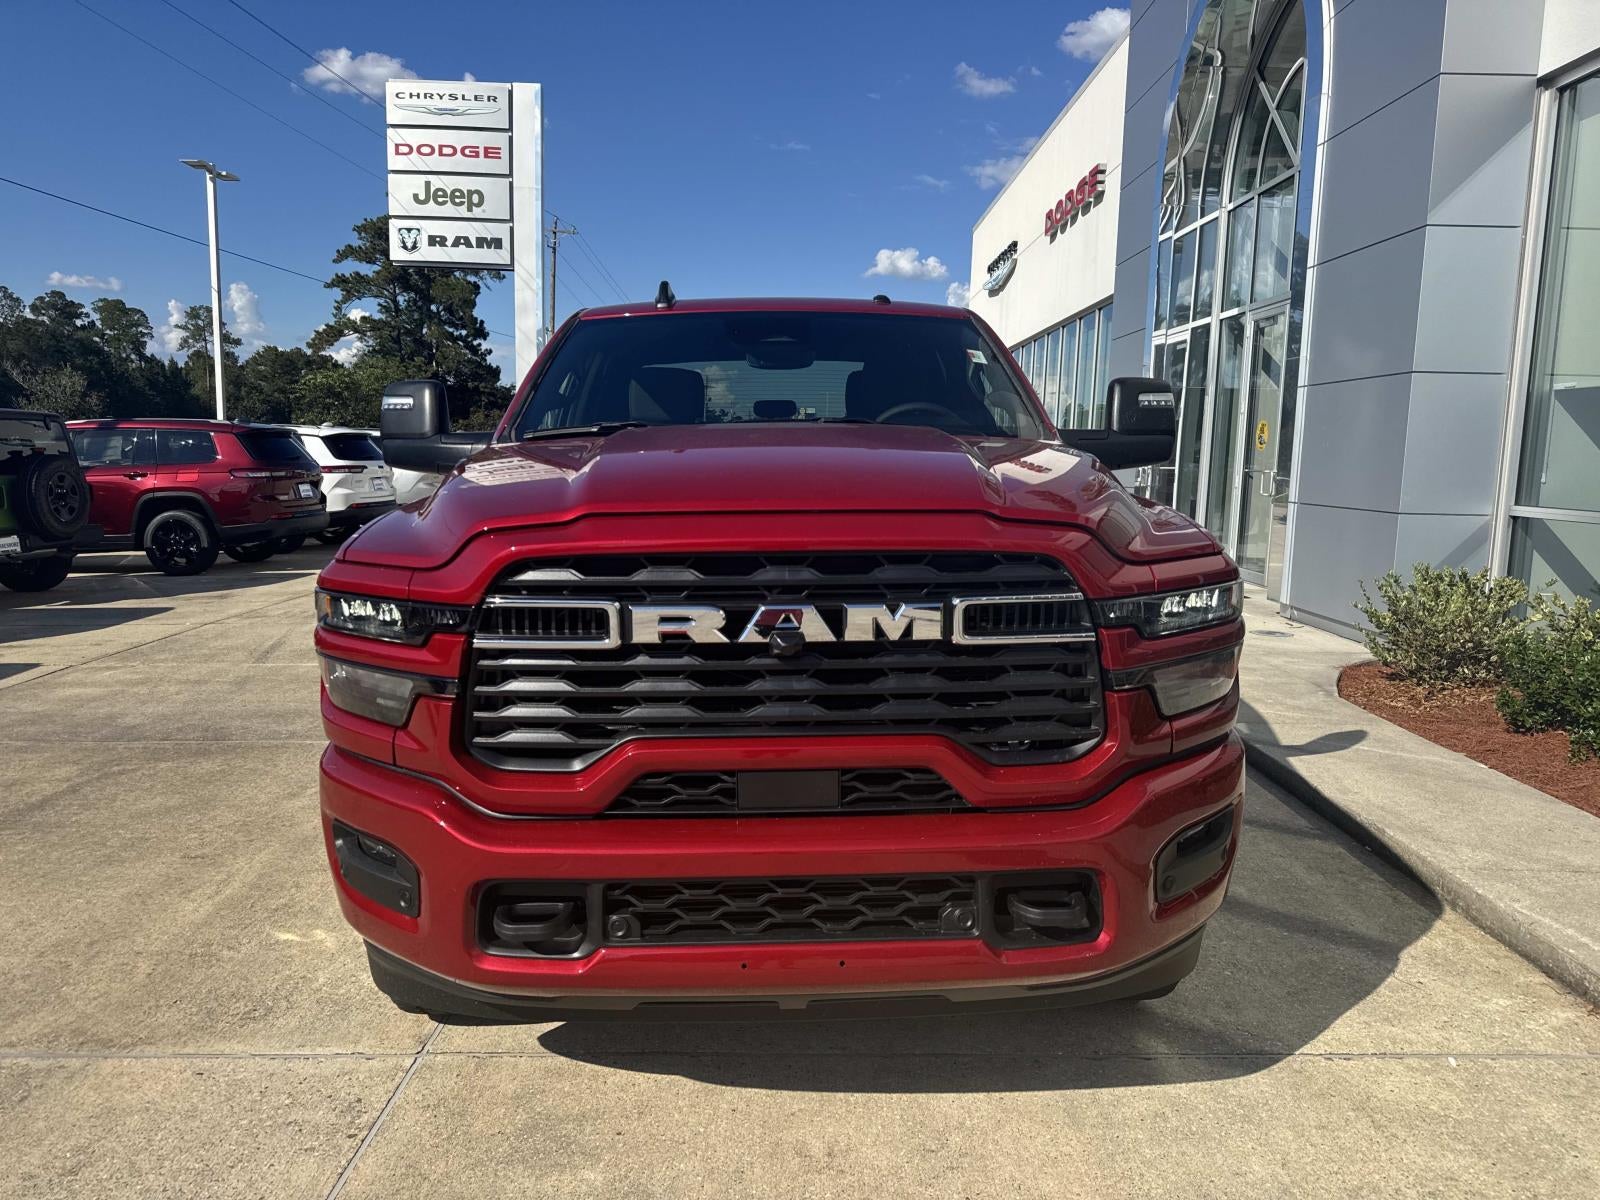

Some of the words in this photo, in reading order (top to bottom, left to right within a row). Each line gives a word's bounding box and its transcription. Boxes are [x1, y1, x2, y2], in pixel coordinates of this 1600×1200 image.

[395, 91, 498, 103] CHRYSLER
[394, 143, 502, 160] DODGE
[412, 180, 485, 212] Jeep
[1044, 163, 1106, 237] DODGE
[427, 234, 503, 250] RAM
[628, 602, 944, 643] RAM
